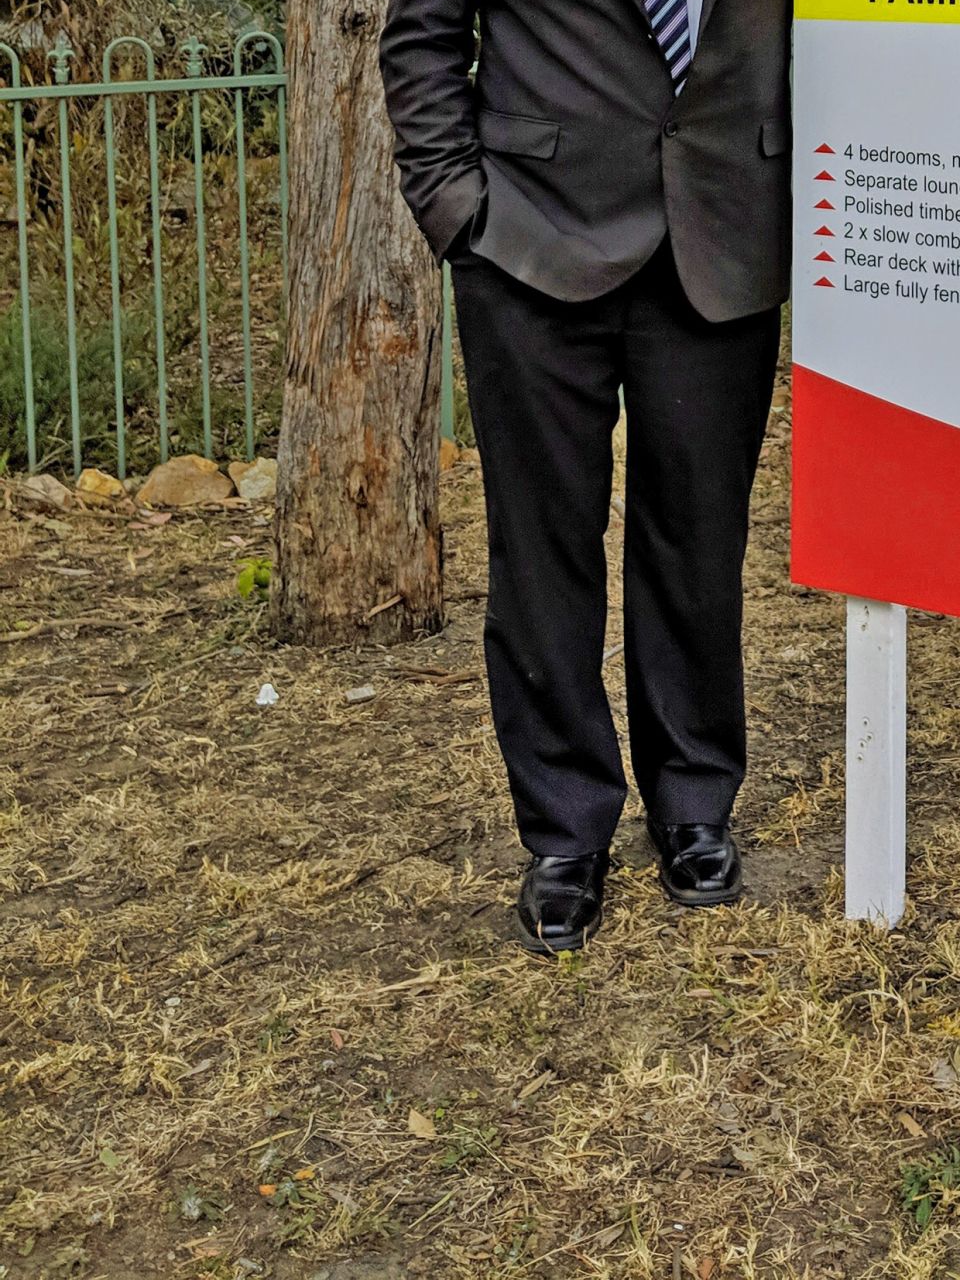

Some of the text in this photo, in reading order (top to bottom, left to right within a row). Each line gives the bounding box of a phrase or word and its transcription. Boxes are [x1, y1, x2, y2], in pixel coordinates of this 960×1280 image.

[843, 143, 854, 160] 4
[859, 144, 946, 170] bedrooms,
[844, 169, 918, 192] Separate
[844, 195, 914, 218] Polished
[844, 221, 854, 239] 2
[859, 227, 868, 241] x
[873, 225, 910, 244] slow
[844, 247, 884, 268] Rear
[888, 253, 928, 273] deck
[844, 274, 890, 299] Large
[895, 279, 929, 304] fully
